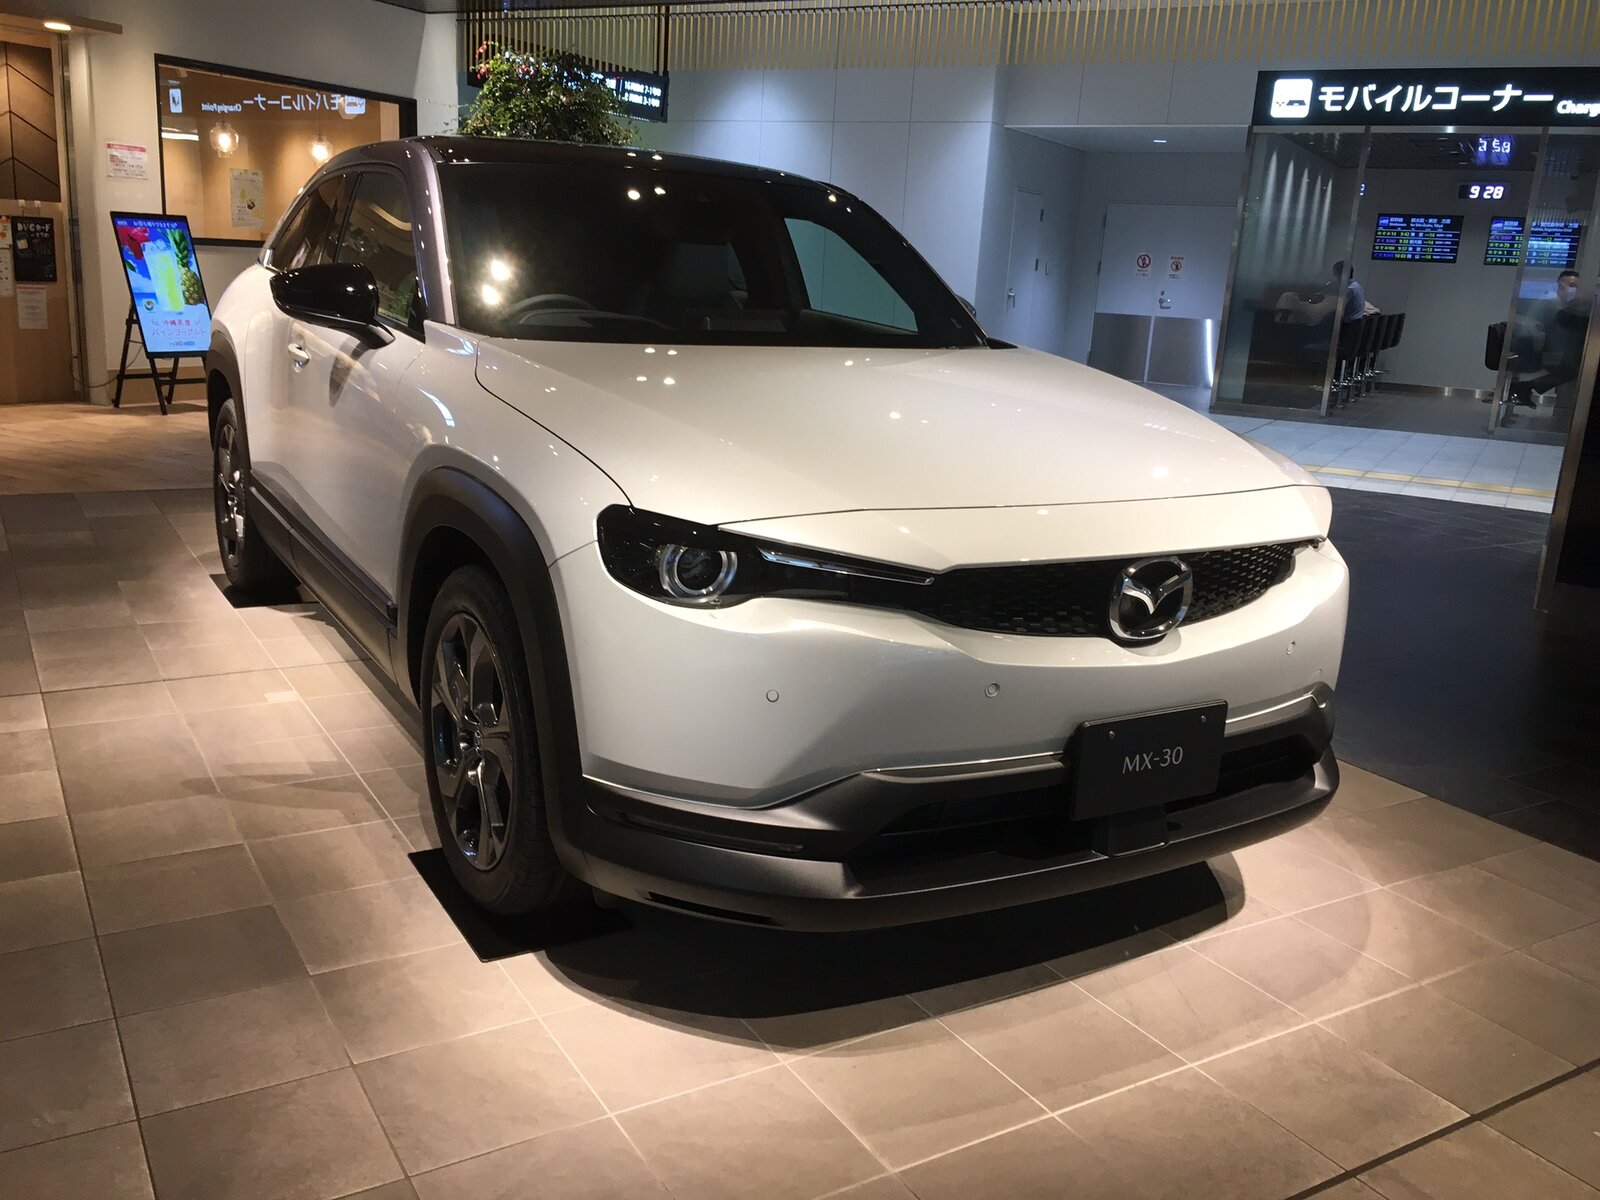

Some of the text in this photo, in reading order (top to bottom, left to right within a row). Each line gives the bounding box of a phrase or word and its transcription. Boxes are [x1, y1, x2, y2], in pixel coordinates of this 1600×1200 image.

[1318, 83, 1554, 112] モバイルコーナー
[1122, 746, 1184, 775] MX-30
